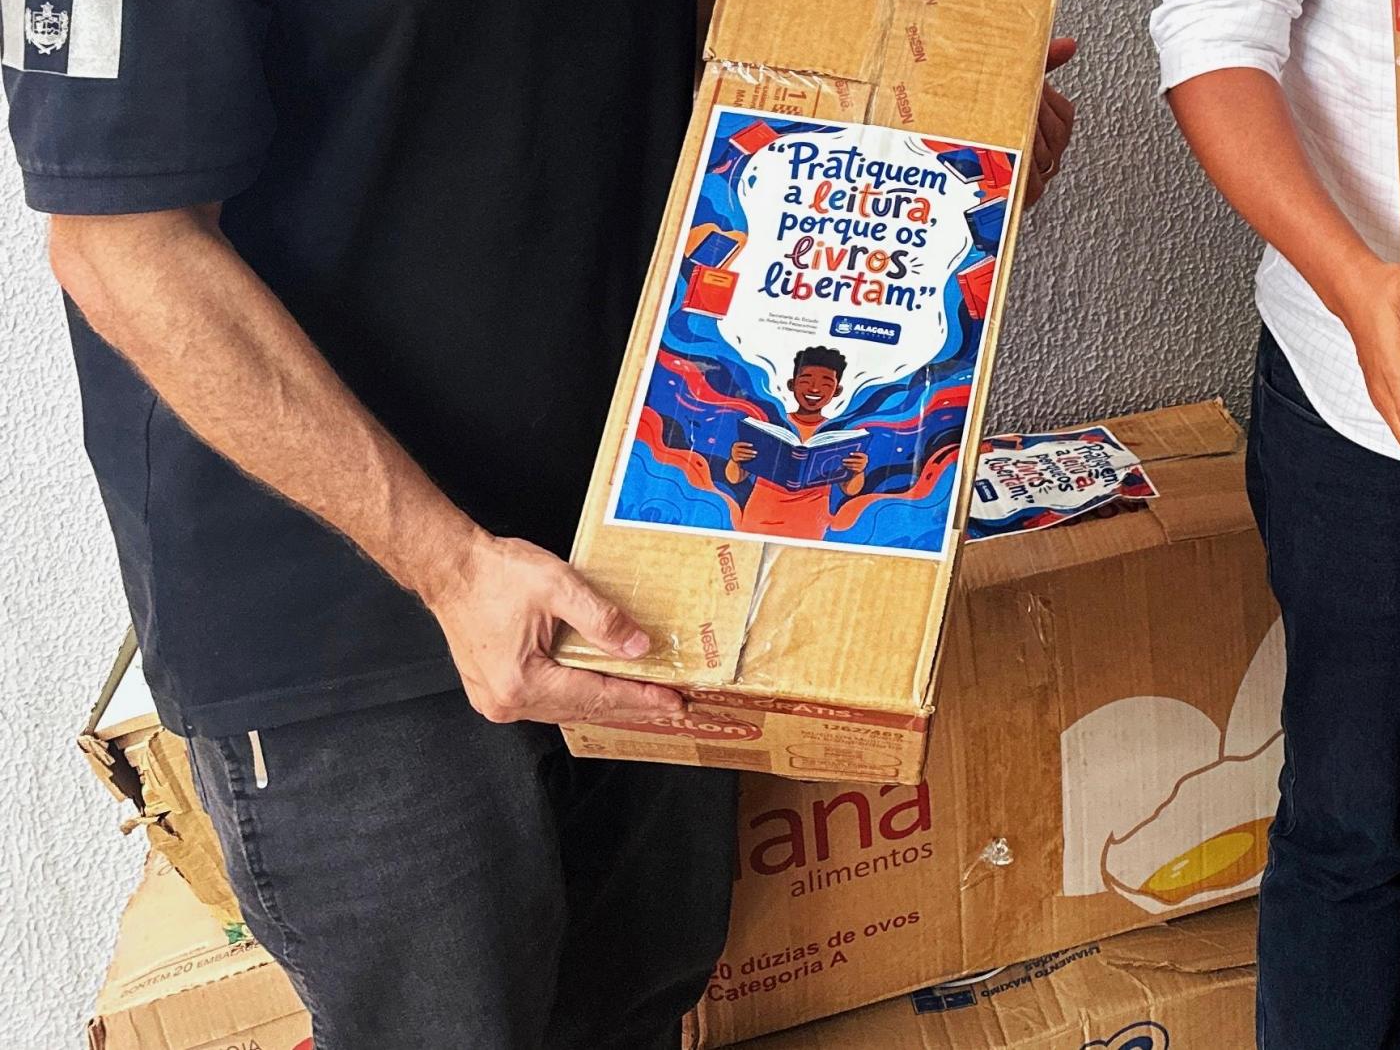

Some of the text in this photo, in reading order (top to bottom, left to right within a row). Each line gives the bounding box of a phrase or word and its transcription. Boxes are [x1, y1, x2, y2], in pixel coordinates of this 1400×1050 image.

[784, 185, 802, 205] a
[777, 212, 928, 248] porque os
[784, 235, 909, 280] livros
[853, 324, 896, 337] ALAGOAS
[1056, 475, 1074, 492] os
[737, 779, 932, 880] ana
[790, 842, 934, 897] alimentos
[740, 942, 820, 976] dúzias
[827, 931, 856, 949] de
[863, 910, 921, 938] ovos
[173, 962, 193, 977] 20
[708, 950, 848, 1001] Categoria A
[1034, 945, 1102, 979] LHAMENTO
